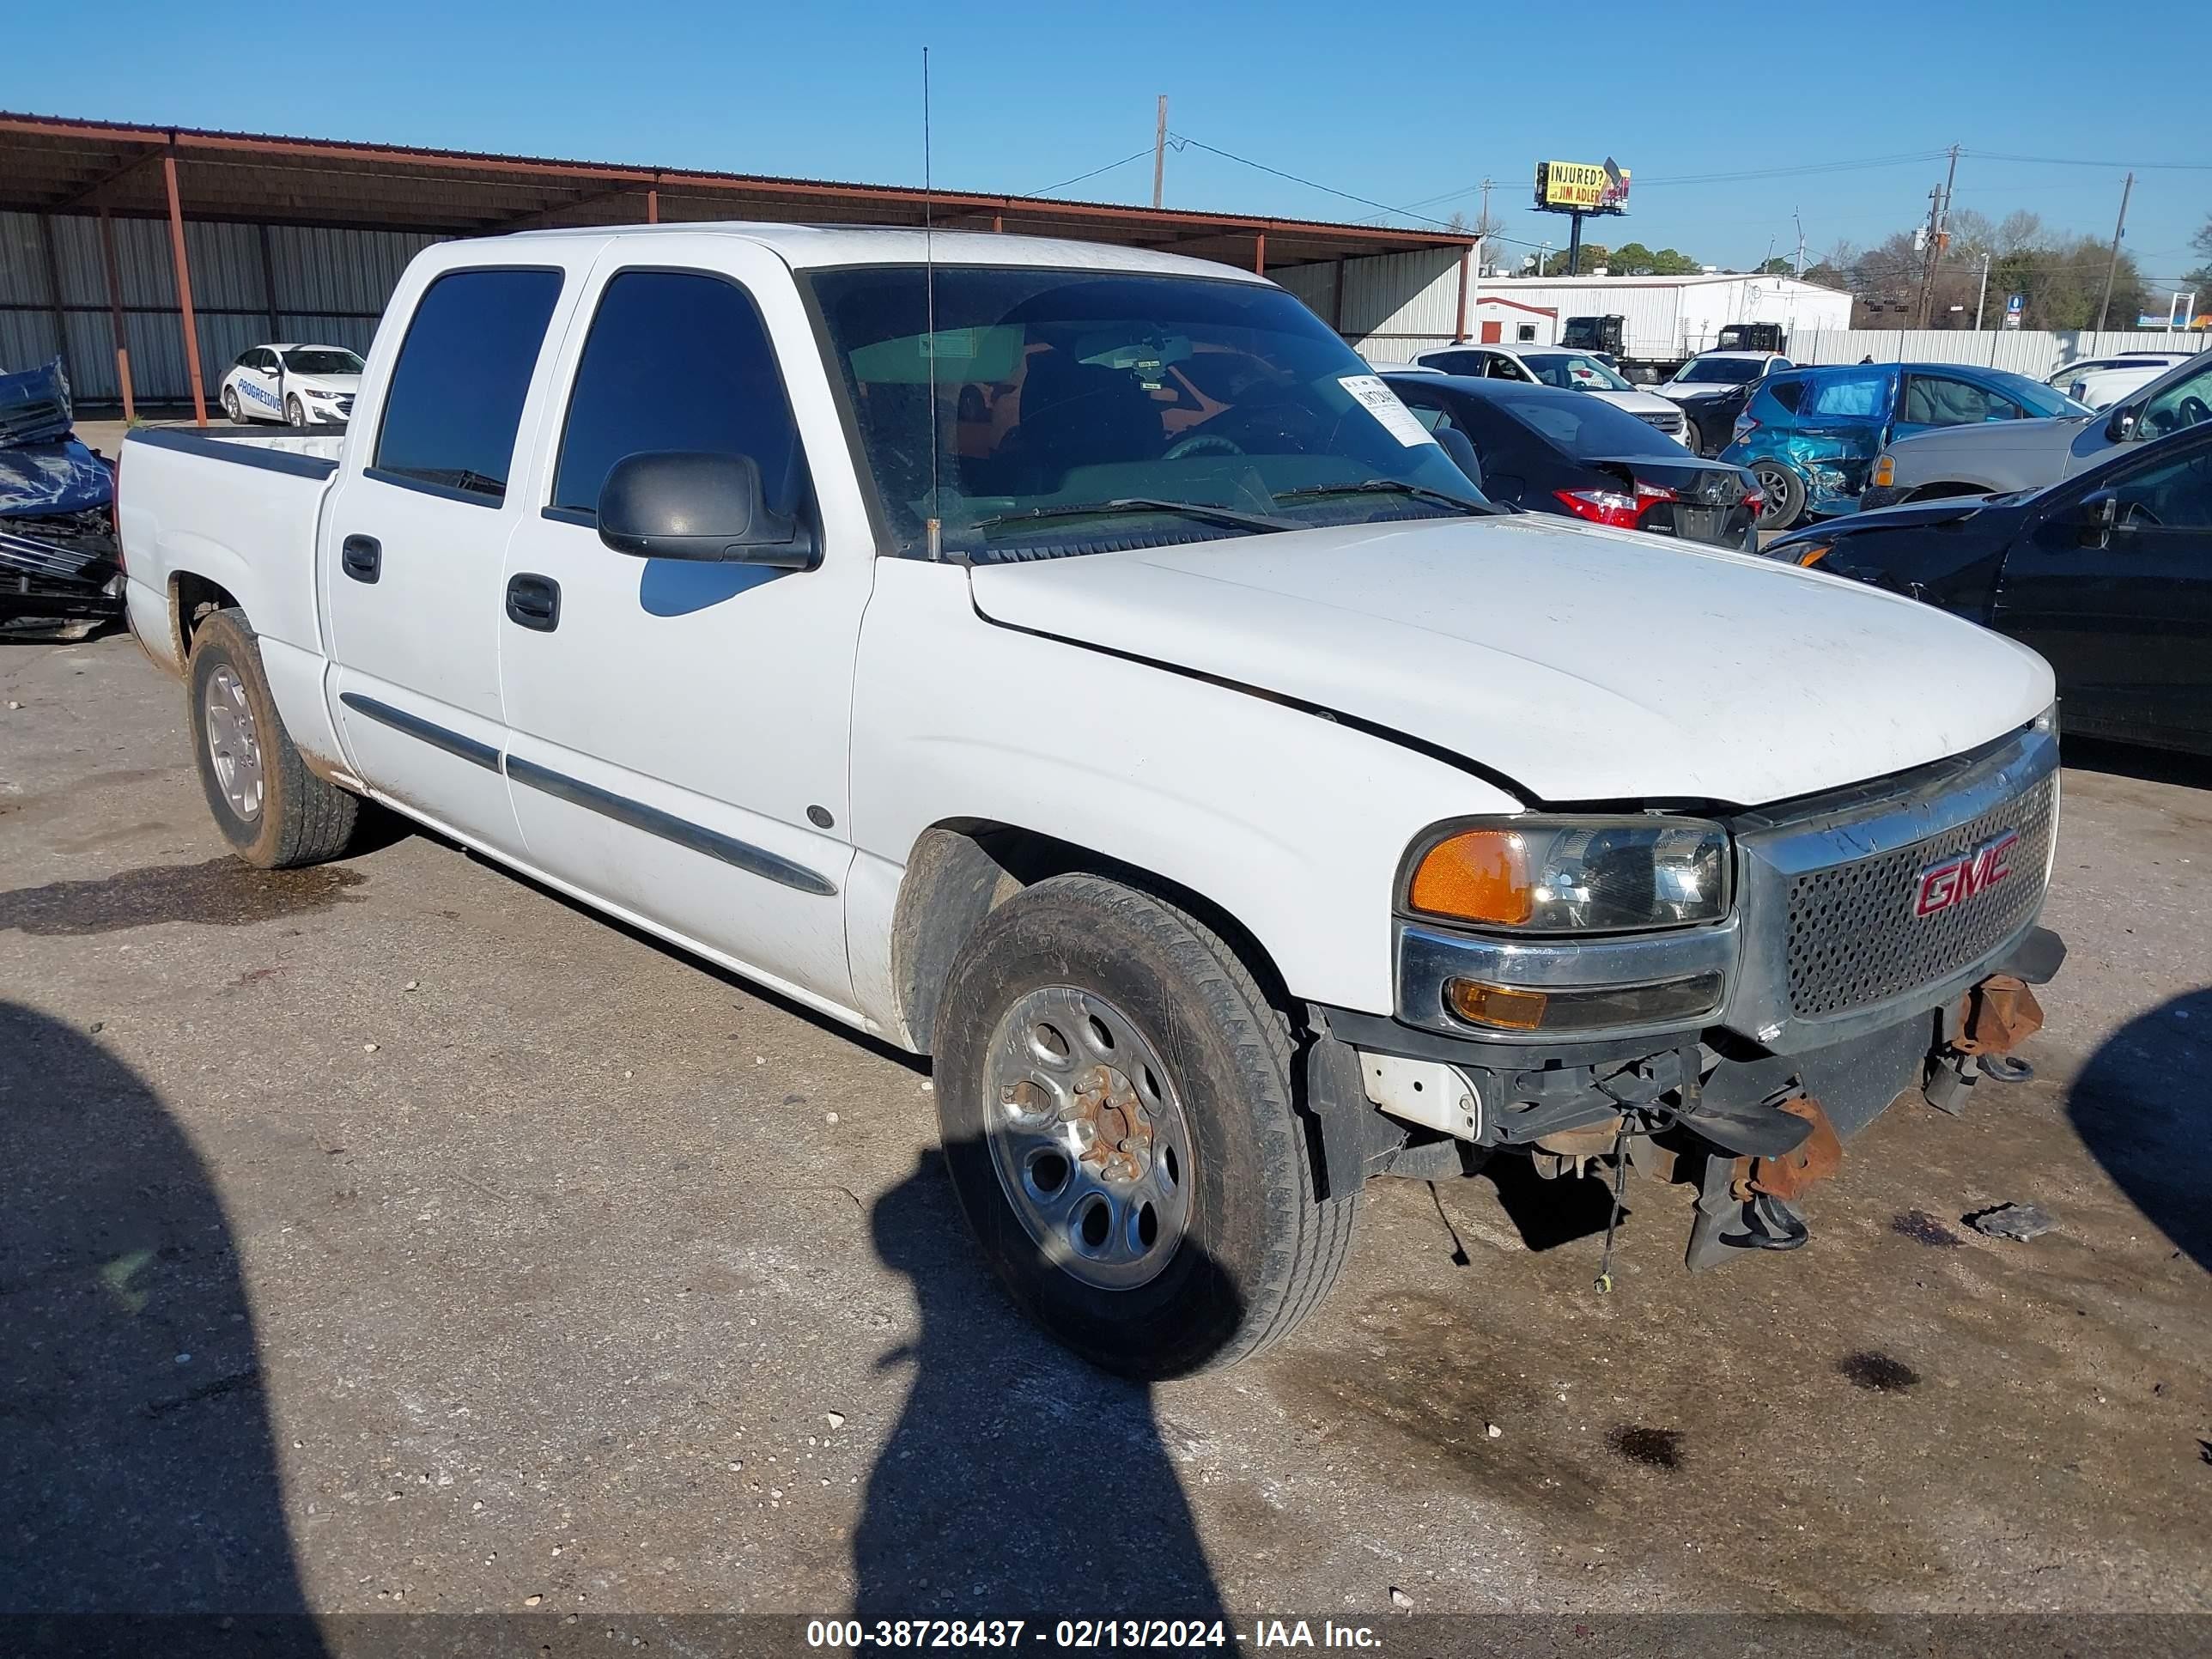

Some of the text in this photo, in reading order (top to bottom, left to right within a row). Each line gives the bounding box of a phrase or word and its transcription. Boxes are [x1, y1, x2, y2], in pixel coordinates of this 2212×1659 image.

[1551, 164, 1604, 186] INJURED?
[1559, 185, 1573, 200] JIM
[1575, 187, 1601, 204] ADLER
[237, 377, 283, 413] PROGRESSIVE
[1914, 830, 2020, 918] GMC
